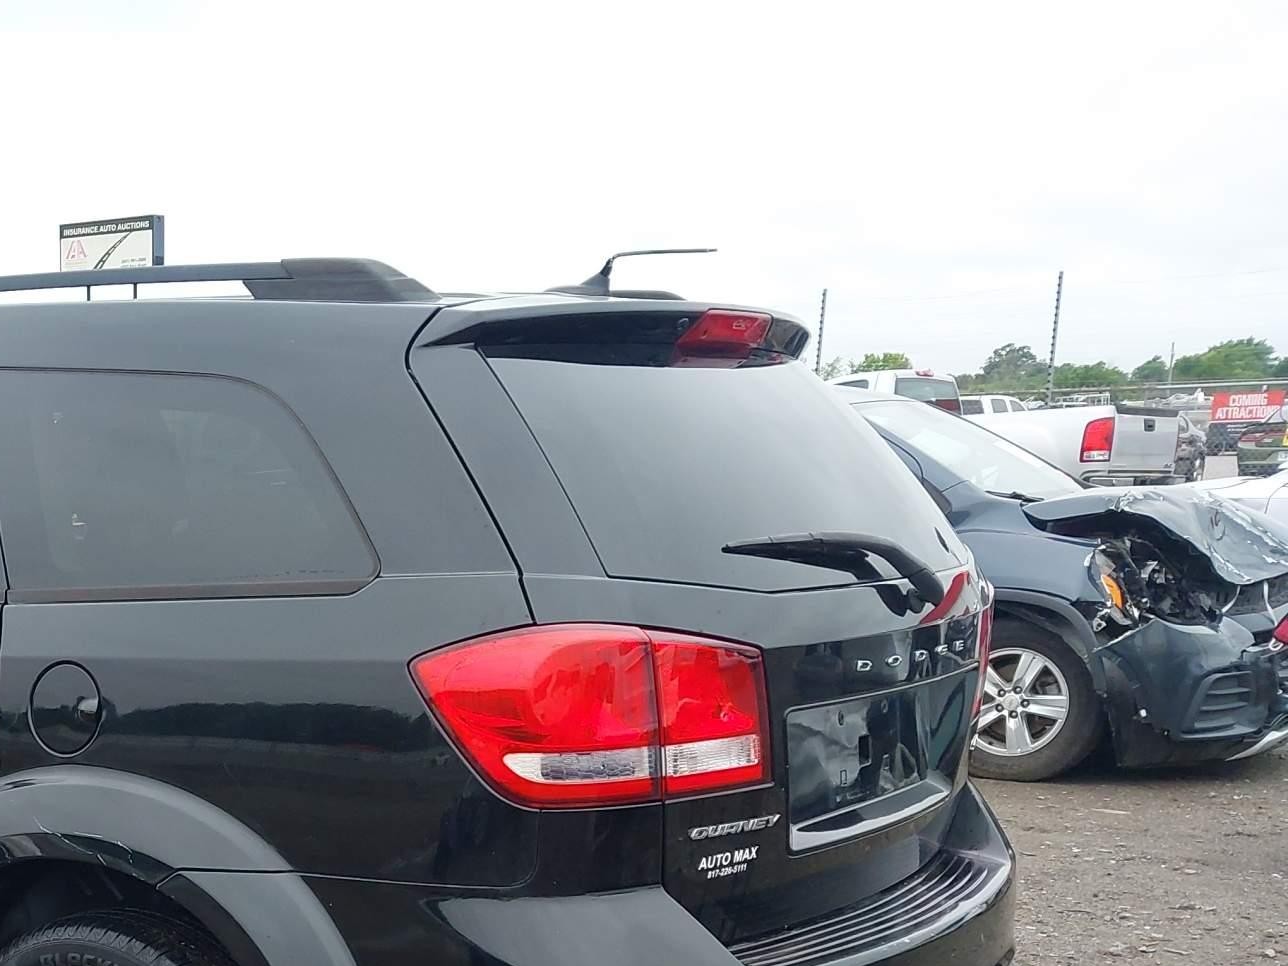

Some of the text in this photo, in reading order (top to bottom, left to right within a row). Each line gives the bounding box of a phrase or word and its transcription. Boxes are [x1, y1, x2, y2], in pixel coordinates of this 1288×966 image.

[63, 220, 150, 237] INSURANCE AUTO AUCTIONS
[1229, 393, 1268, 406] COMING
[698, 846, 759, 871] AUTO MAX
